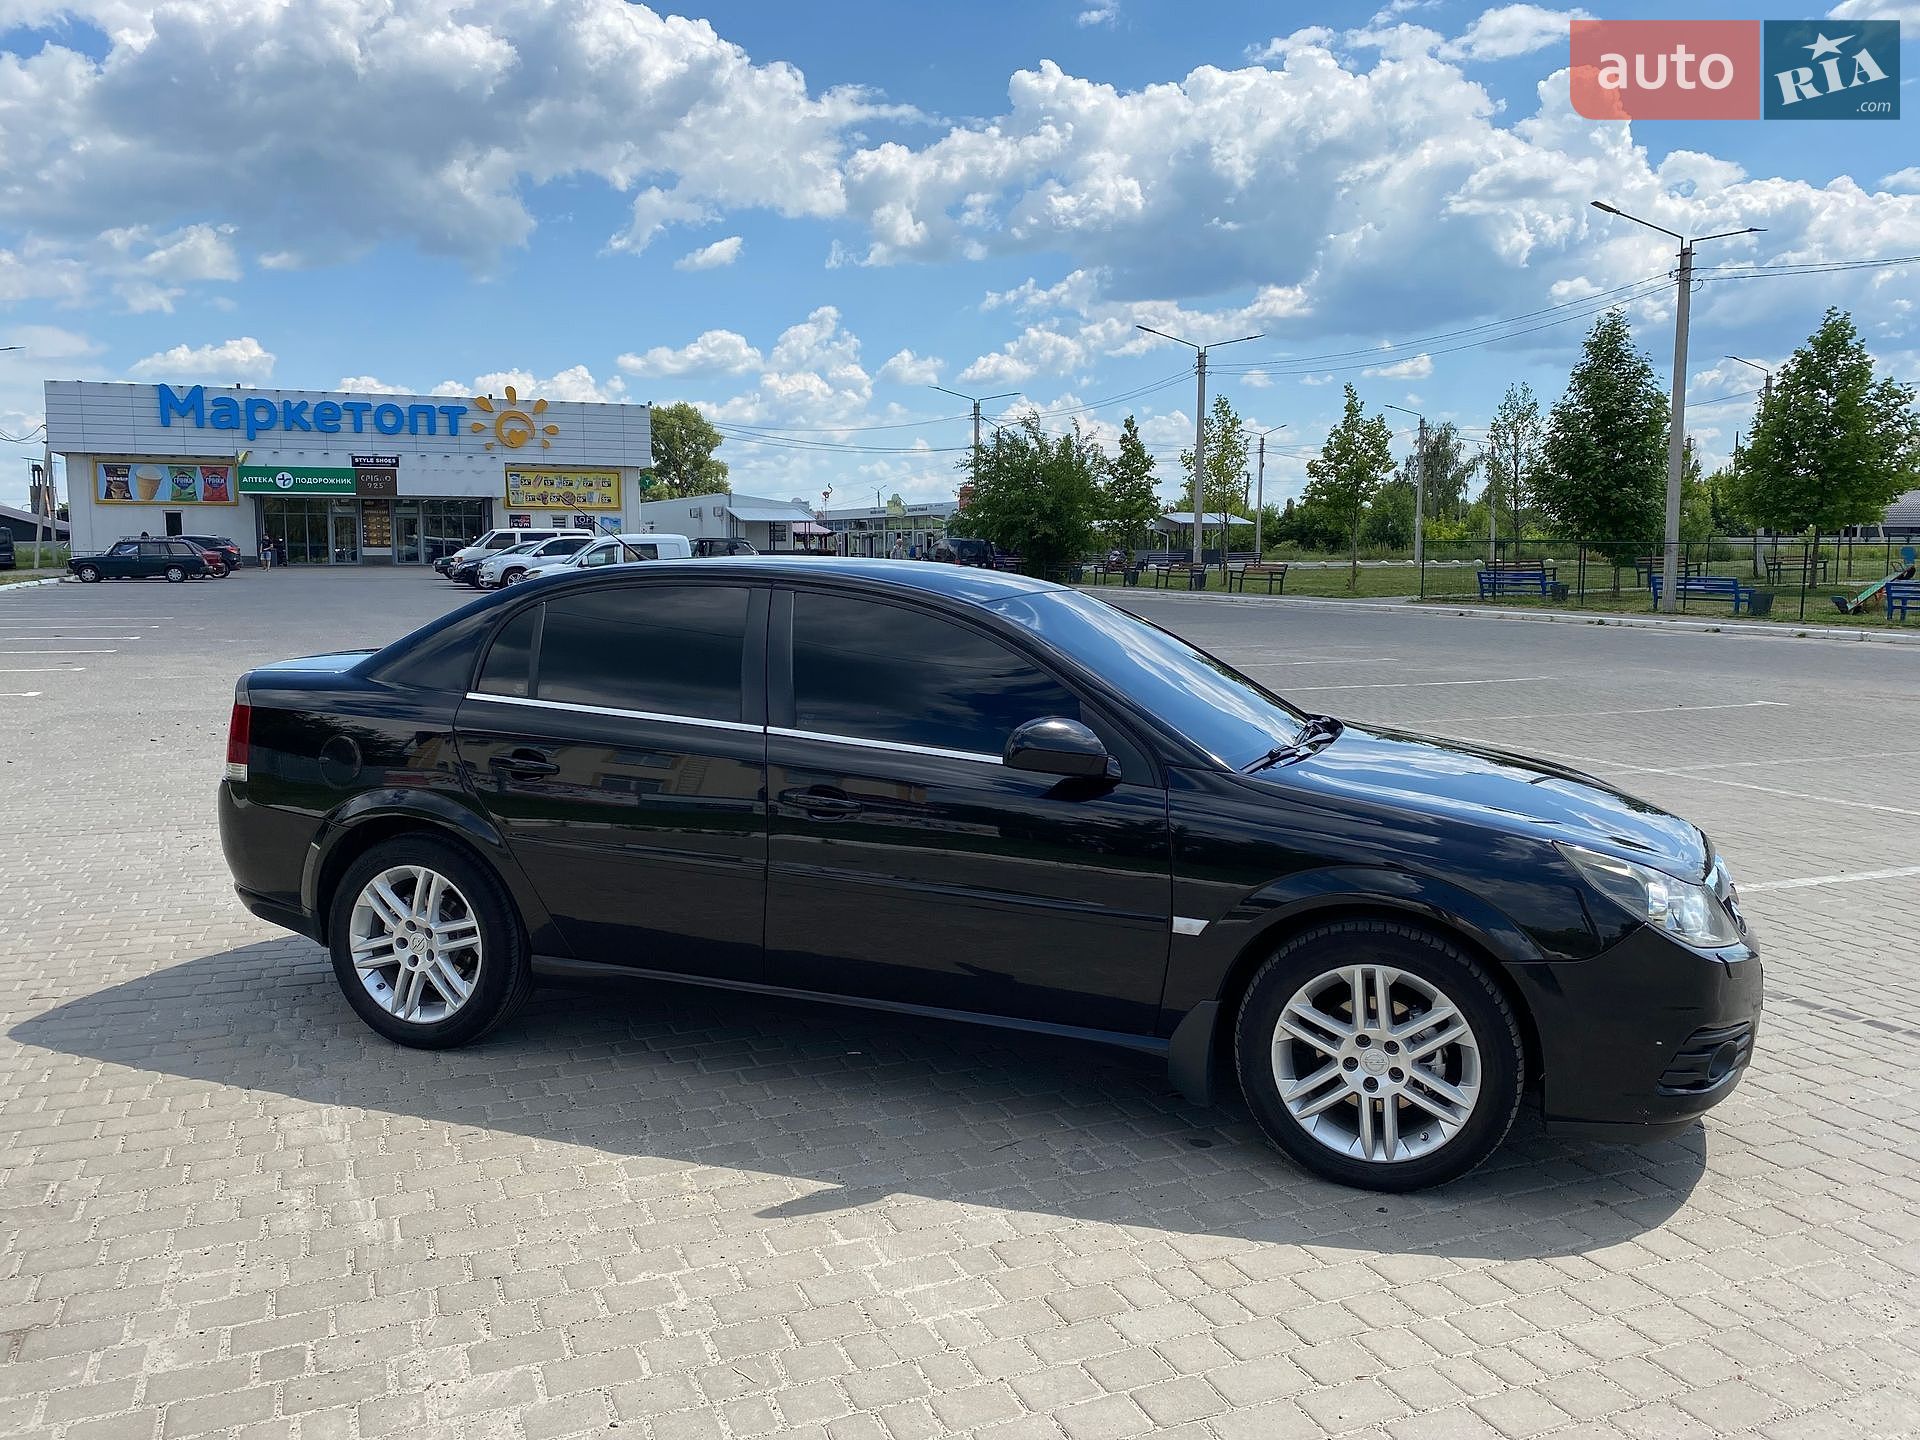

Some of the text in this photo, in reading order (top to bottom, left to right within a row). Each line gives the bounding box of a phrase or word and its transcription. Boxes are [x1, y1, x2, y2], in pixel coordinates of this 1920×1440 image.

[158, 383, 468, 441] Маркетопт
[375, 457, 397, 465] SHOES
[295, 477, 352, 485] ПОДОРОЖНИК
